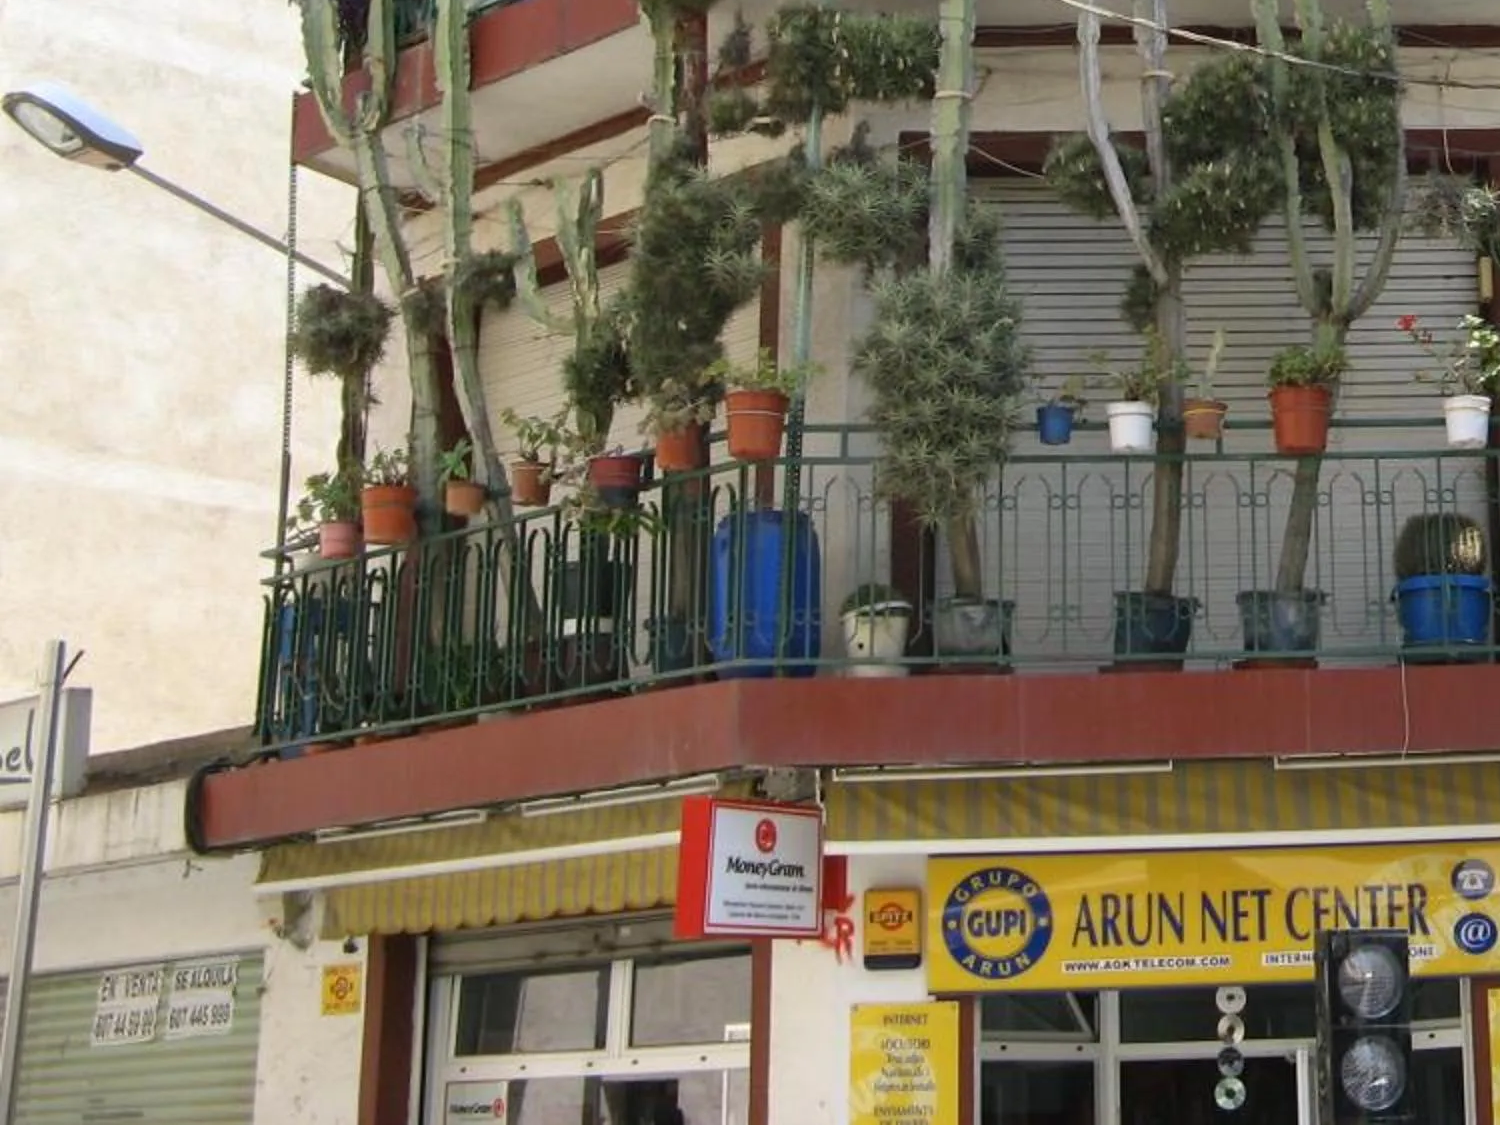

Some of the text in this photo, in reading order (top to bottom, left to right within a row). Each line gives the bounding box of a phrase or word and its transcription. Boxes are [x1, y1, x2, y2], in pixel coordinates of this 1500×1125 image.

[0, 708, 34, 774] el
[726, 856, 804, 879] MoneyGram
[955, 870, 1039, 902] GRUPO
[967, 909, 1025, 937] GUPI
[1072, 882, 1431, 948] ARUN NET CENTER
[961, 955, 1030, 976] ARUN
